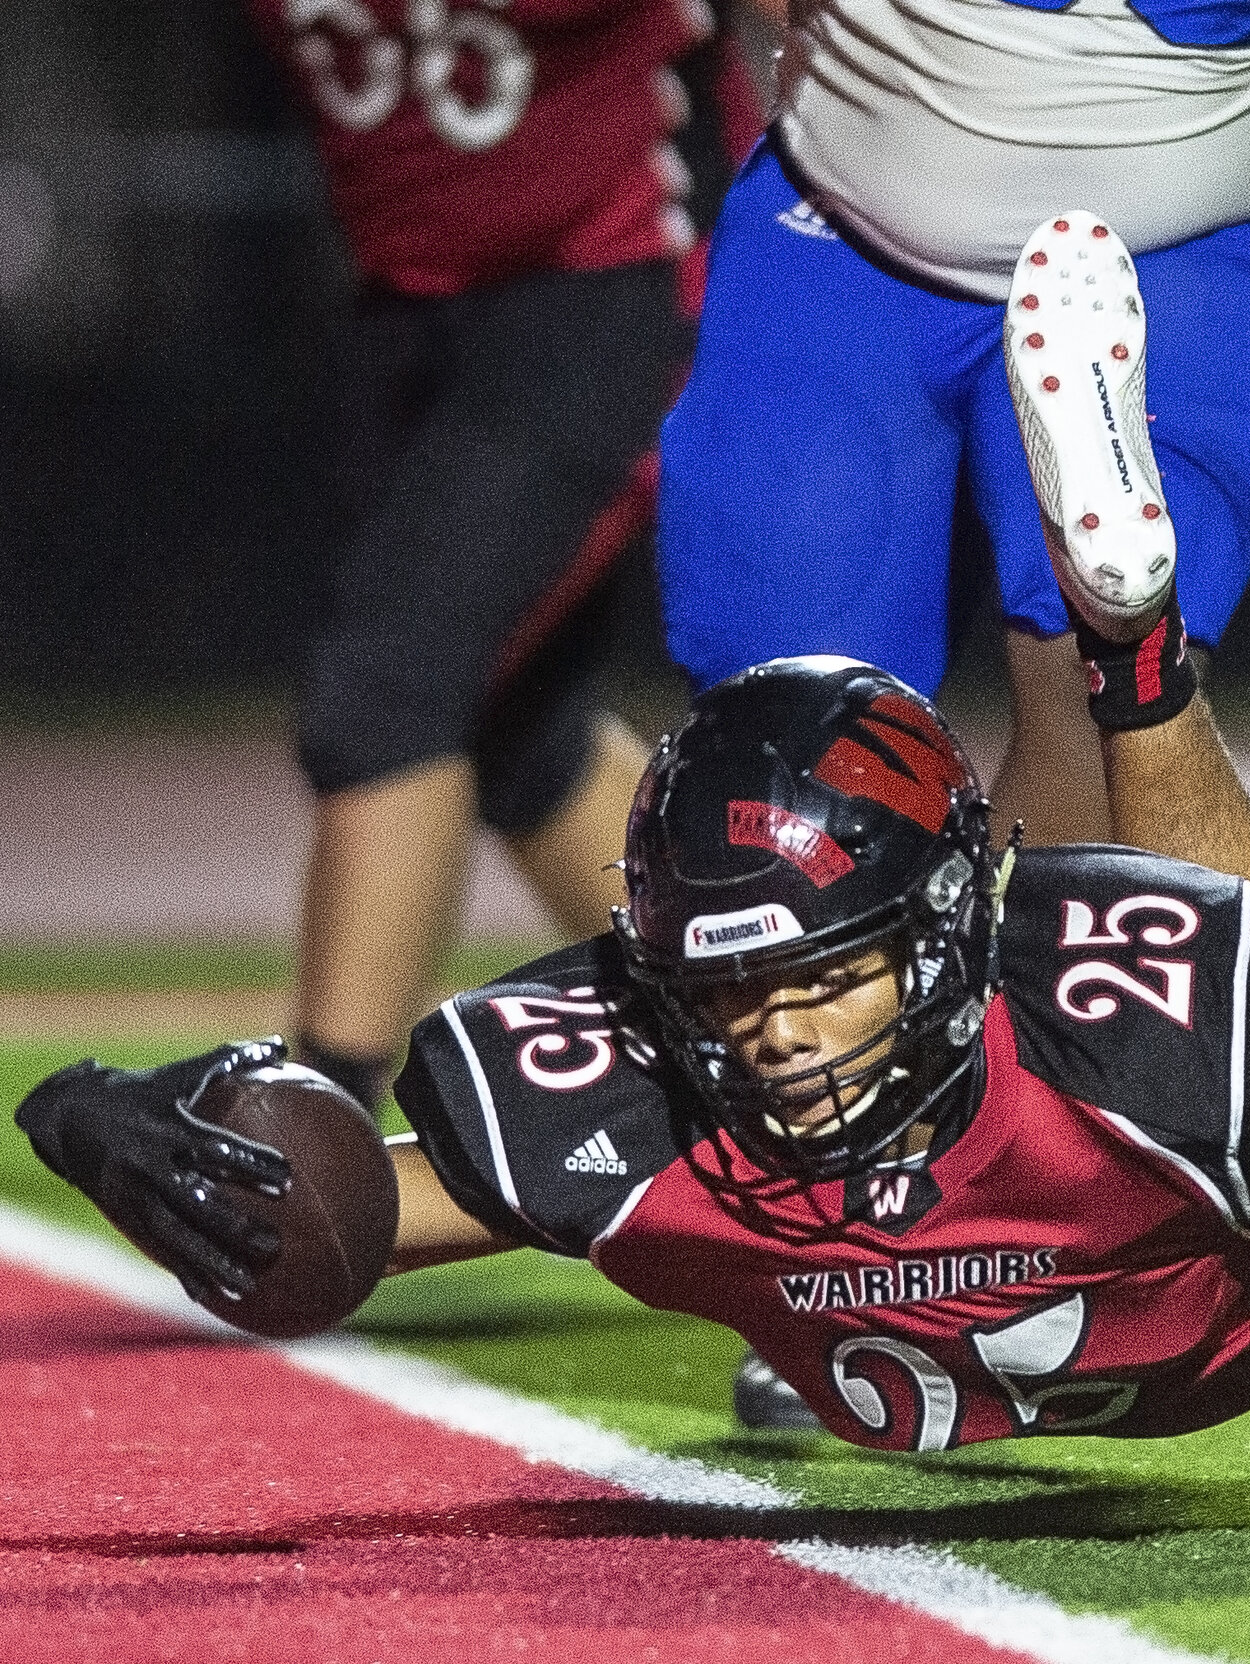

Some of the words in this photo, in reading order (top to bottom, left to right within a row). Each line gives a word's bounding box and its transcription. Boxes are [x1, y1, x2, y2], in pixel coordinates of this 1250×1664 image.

[1091, 361, 1118, 434] ARMOUR
[1111, 438, 1133, 494] UNDER
[1056, 890, 1201, 1030] 25
[564, 1156, 628, 1176] adidas
[867, 1173, 910, 1222] W
[776, 1247, 1062, 1313] WARRIORS
